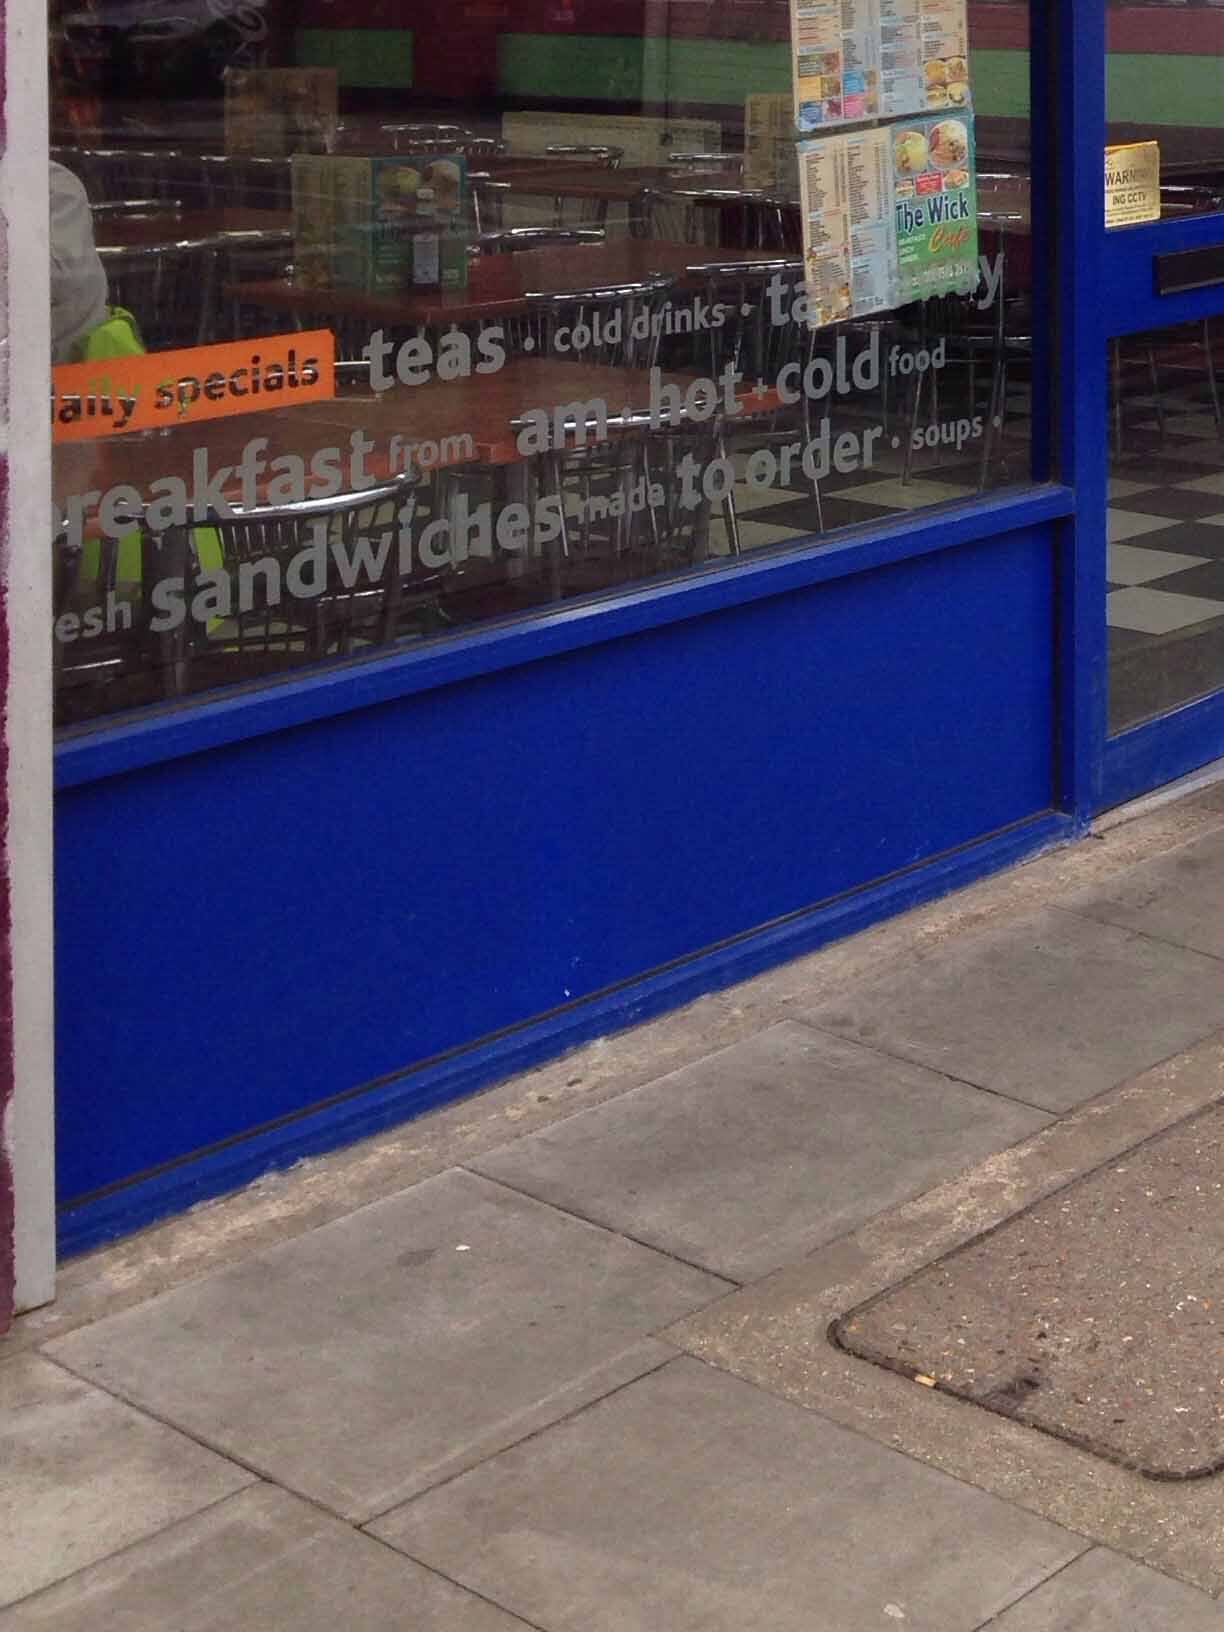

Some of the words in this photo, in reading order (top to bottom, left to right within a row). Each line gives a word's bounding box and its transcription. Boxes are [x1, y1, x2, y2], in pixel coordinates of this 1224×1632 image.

[896, 202, 923, 234] The
[927, 192, 969, 225] Wick
[1128, 190, 1147, 203] CCTV
[362, 325, 506, 392] teas
[554, 306, 622, 353] cold
[631, 297, 725, 341] drinks
[52, 375, 141, 428] aily
[154, 349, 320, 416] specials
[390, 433, 474, 474] from
[516, 398, 608, 455] am
[649, 359, 744, 430] hot
[776, 329, 880, 405] cold
[889, 338, 946, 377] food
[150, 492, 562, 633] sandwiches
[676, 453, 736, 511] to
[746, 417, 884, 490] order
[911, 413, 983, 451] soups
